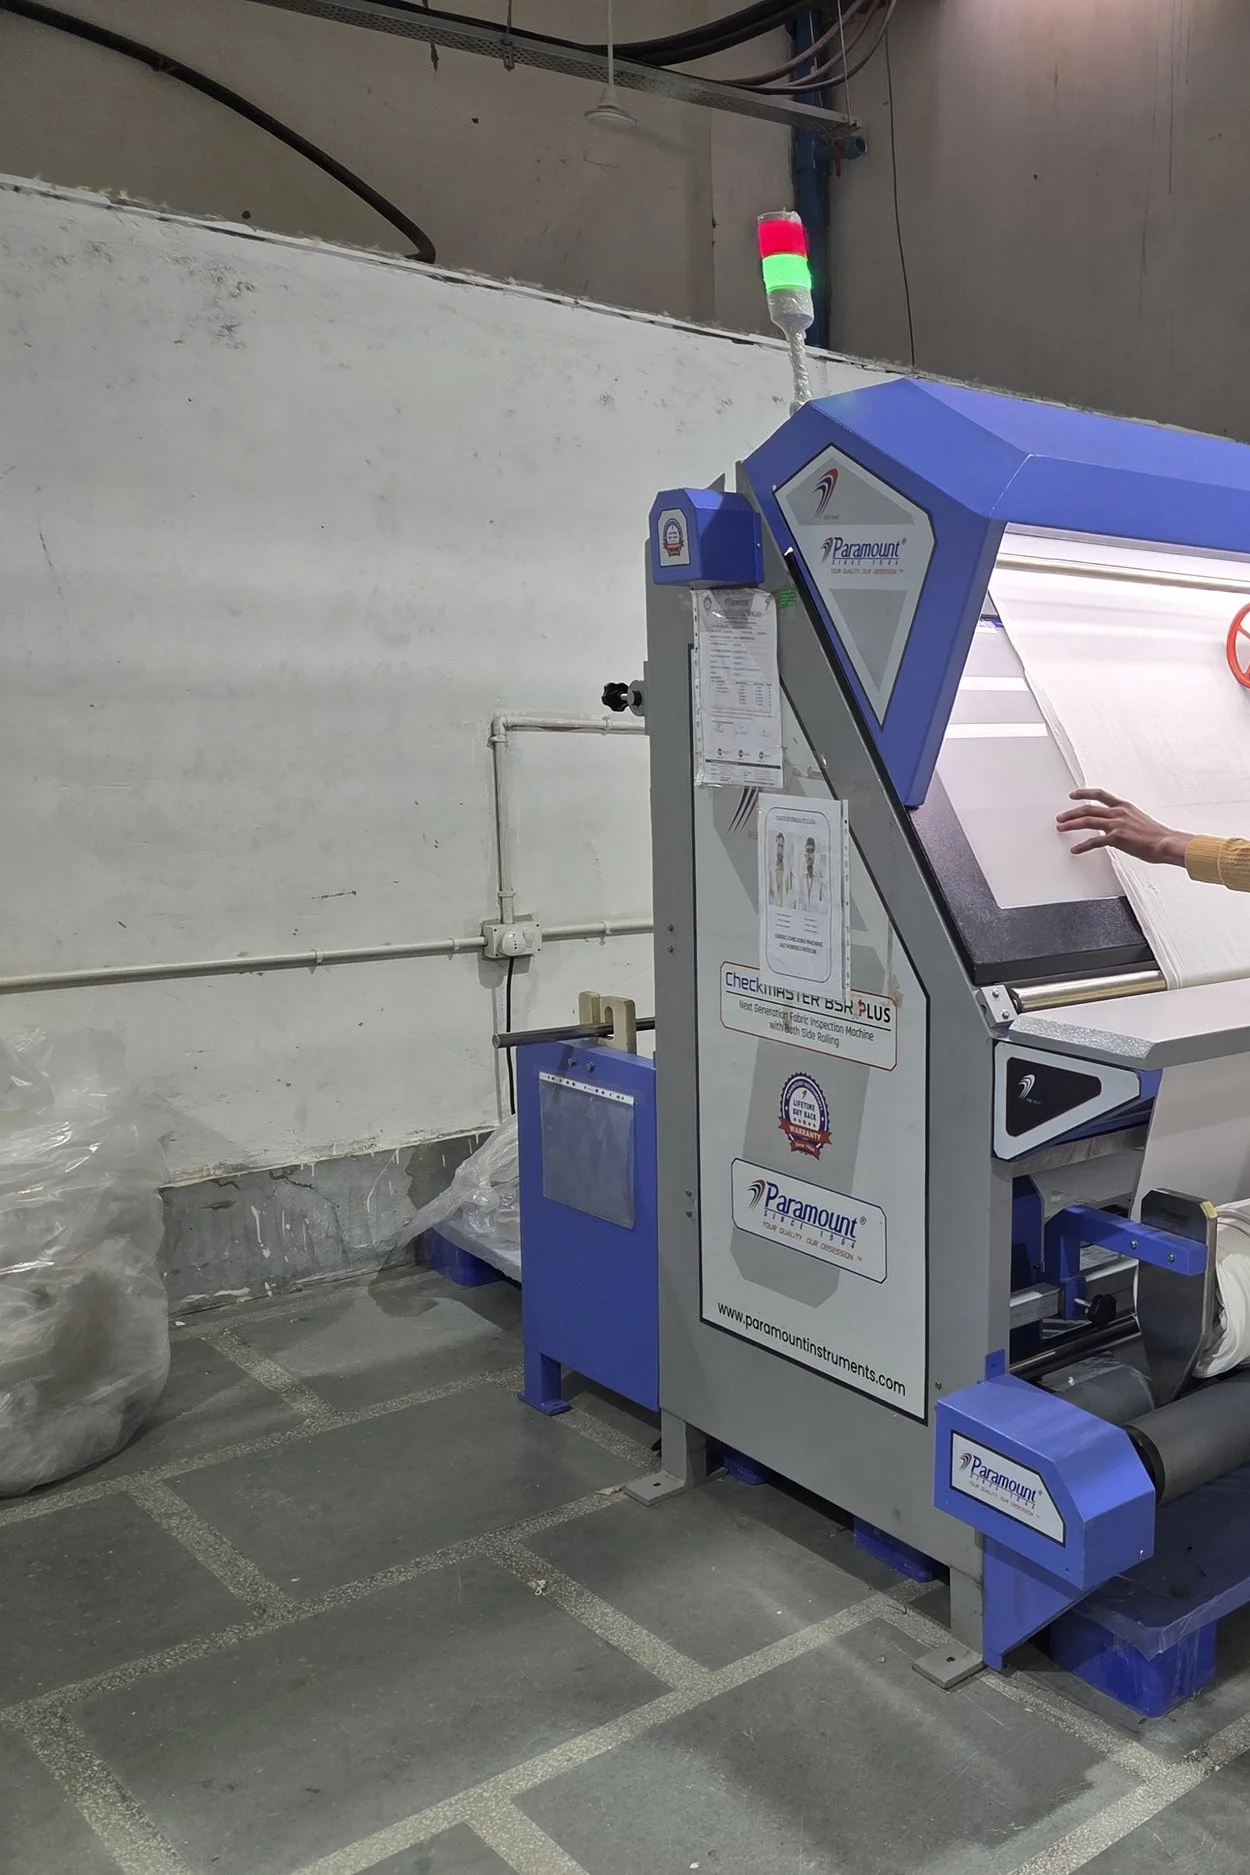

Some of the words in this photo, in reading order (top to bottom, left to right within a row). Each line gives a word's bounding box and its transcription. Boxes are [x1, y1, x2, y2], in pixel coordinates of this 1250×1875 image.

[832, 536, 900, 558] Paramount
[739, 1000, 753, 1013] Next
[754, 1001, 789, 1020] Generation
[790, 1011, 809, 1026] Fabric
[810, 1015, 844, 1035] Inspection
[845, 1025, 874, 1042] Machine
[857, 999, 891, 1024] PLUS
[769, 1020, 783, 1032] with
[801, 1027, 816, 1040] Side
[817, 1030, 840, 1048] Rolling
[789, 1125, 822, 1141] WARRANTY
[764, 1181, 858, 1239] Paramount
[806, 1237, 819, 1247] OUR
[820, 1242, 854, 1261] OBSESSION
[820, 1230, 856, 1249] 1964
[717, 1301, 906, 1397] www.paramountinstruments.com
[971, 1455, 1036, 1503] Paramount
